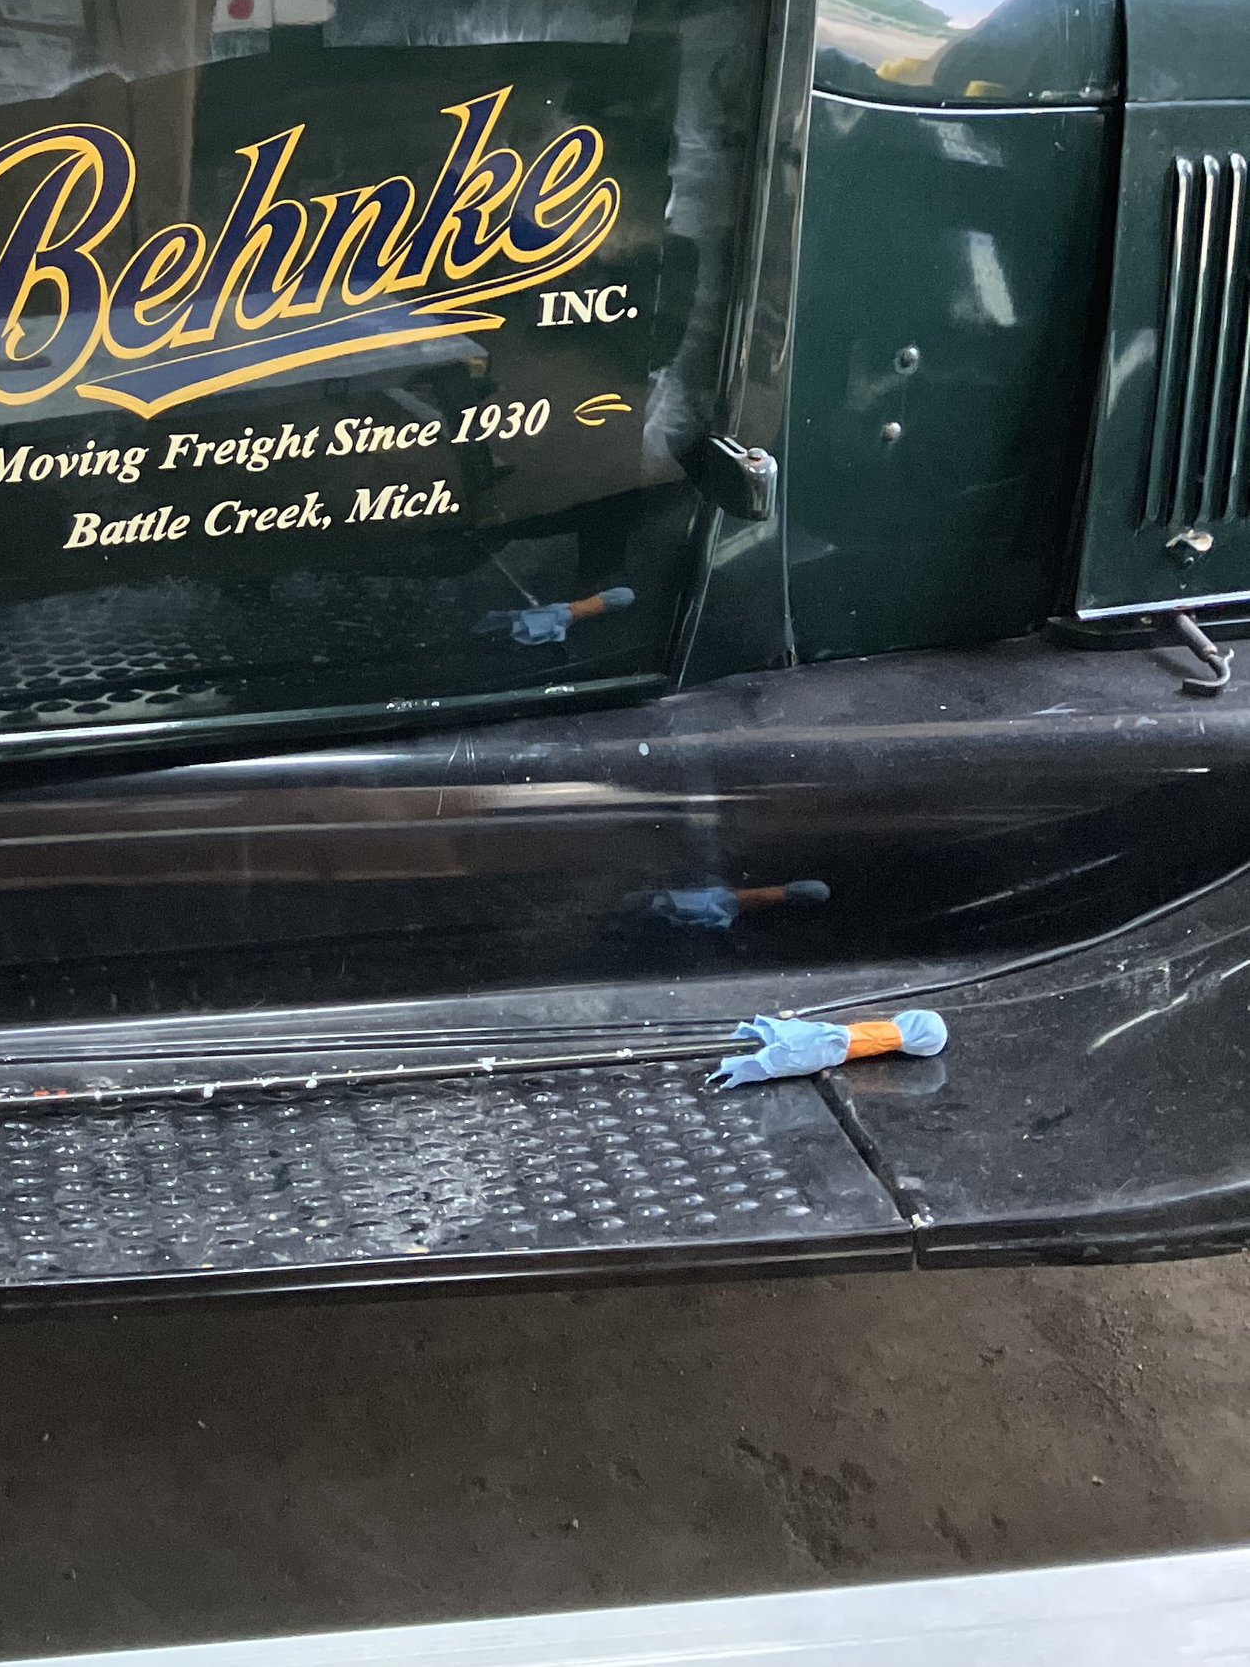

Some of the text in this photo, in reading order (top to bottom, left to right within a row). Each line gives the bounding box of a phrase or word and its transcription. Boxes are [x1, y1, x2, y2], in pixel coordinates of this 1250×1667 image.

[537, 284, 638, 327] INC.
[157, 423, 320, 472] Freight
[325, 415, 442, 456] Since
[450, 398, 551, 444] 1930
[62, 479, 460, 549] Battle Creek, Mich.
